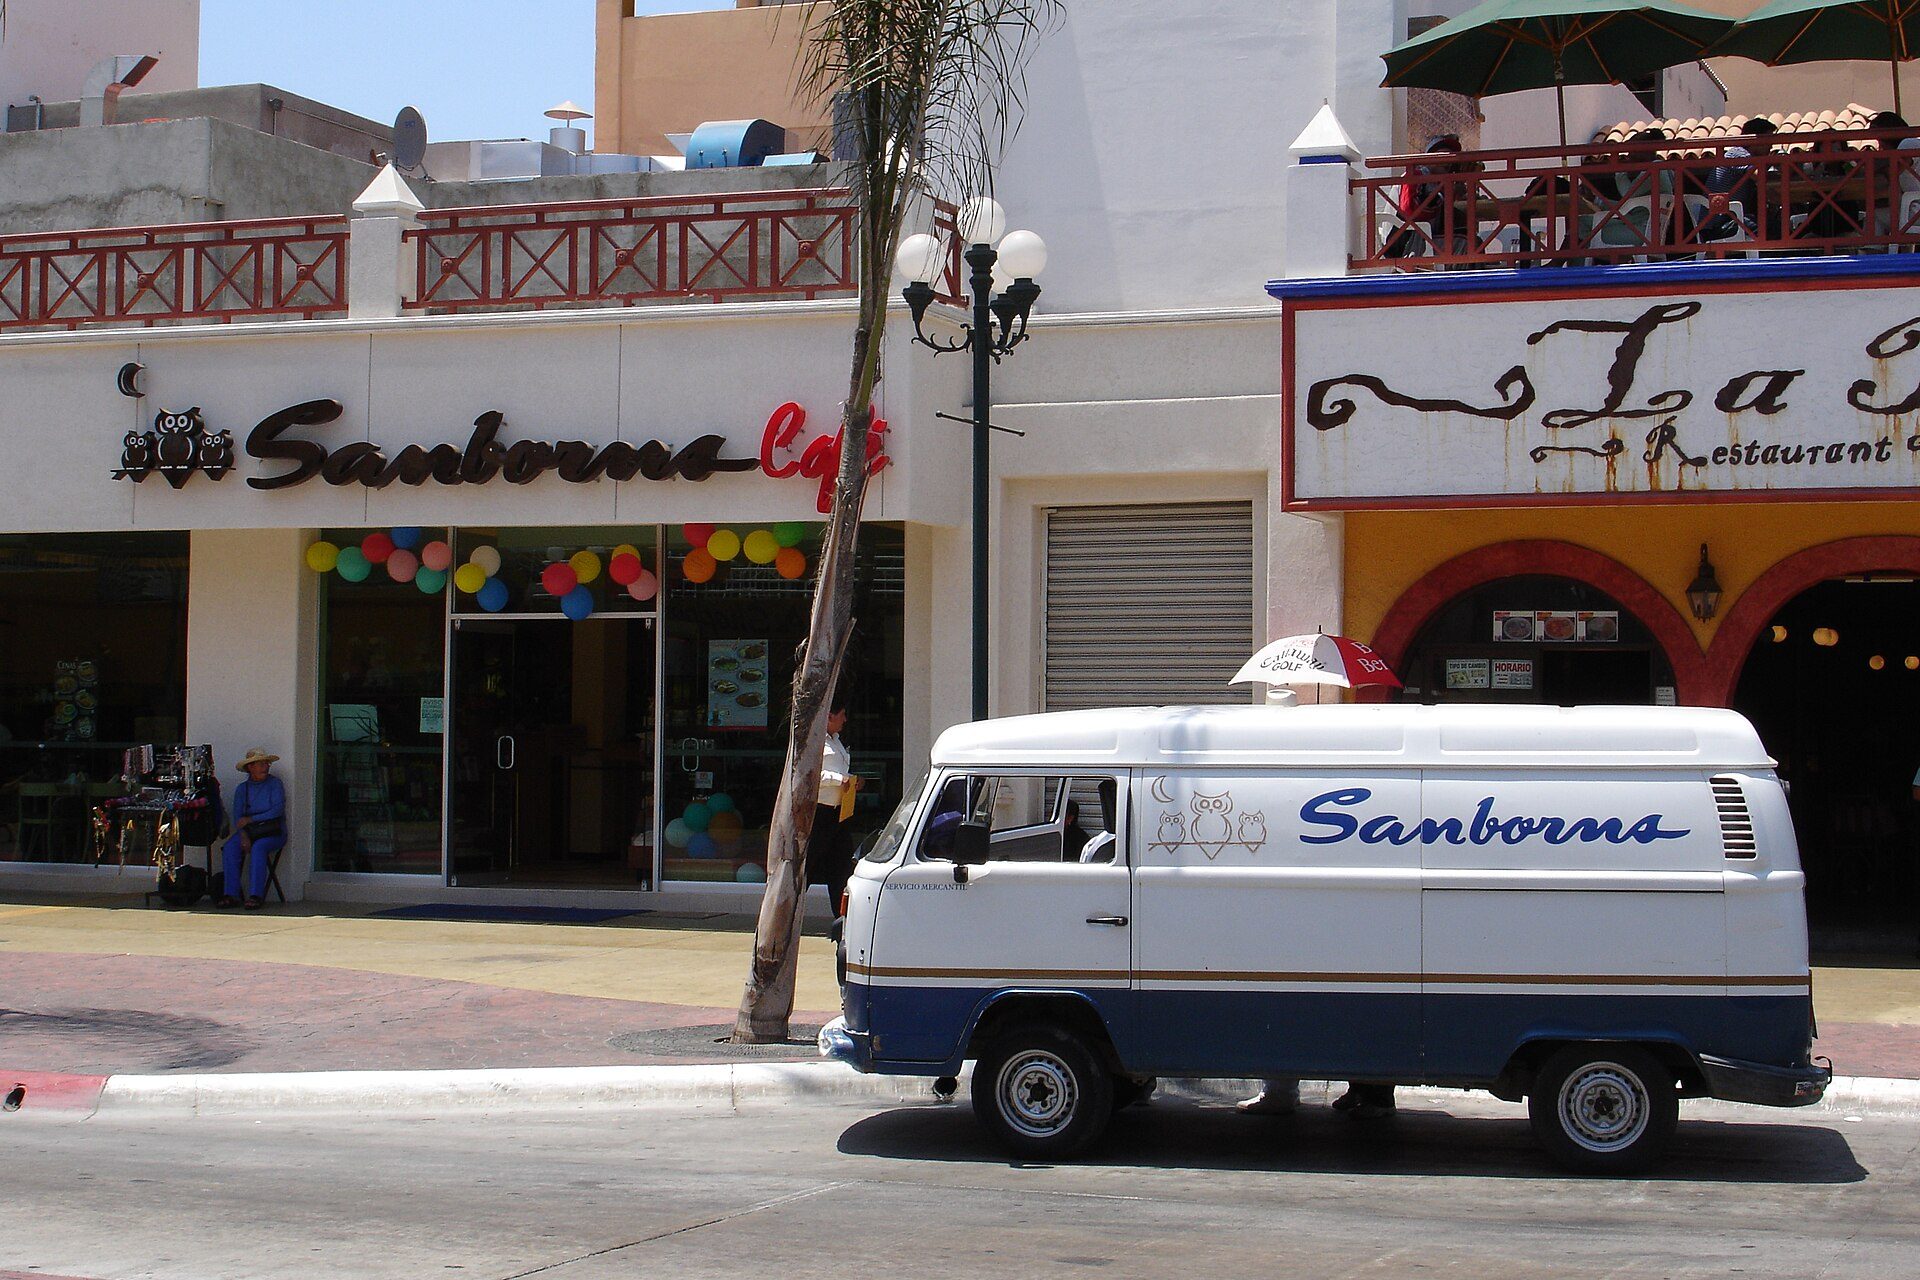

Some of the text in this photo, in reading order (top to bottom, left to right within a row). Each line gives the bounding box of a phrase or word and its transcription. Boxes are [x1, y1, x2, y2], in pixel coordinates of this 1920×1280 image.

[1526, 301, 1806, 429] La
[245, 398, 761, 490] Sanborns
[1643, 415, 1894, 467] Restaurant
[1271, 660, 1303, 672] GOLF
[1494, 662, 1531, 673] HORARIO
[1299, 787, 1691, 845] Sanborns
[885, 882, 968, 891] SERVICIO MERCANTIL
